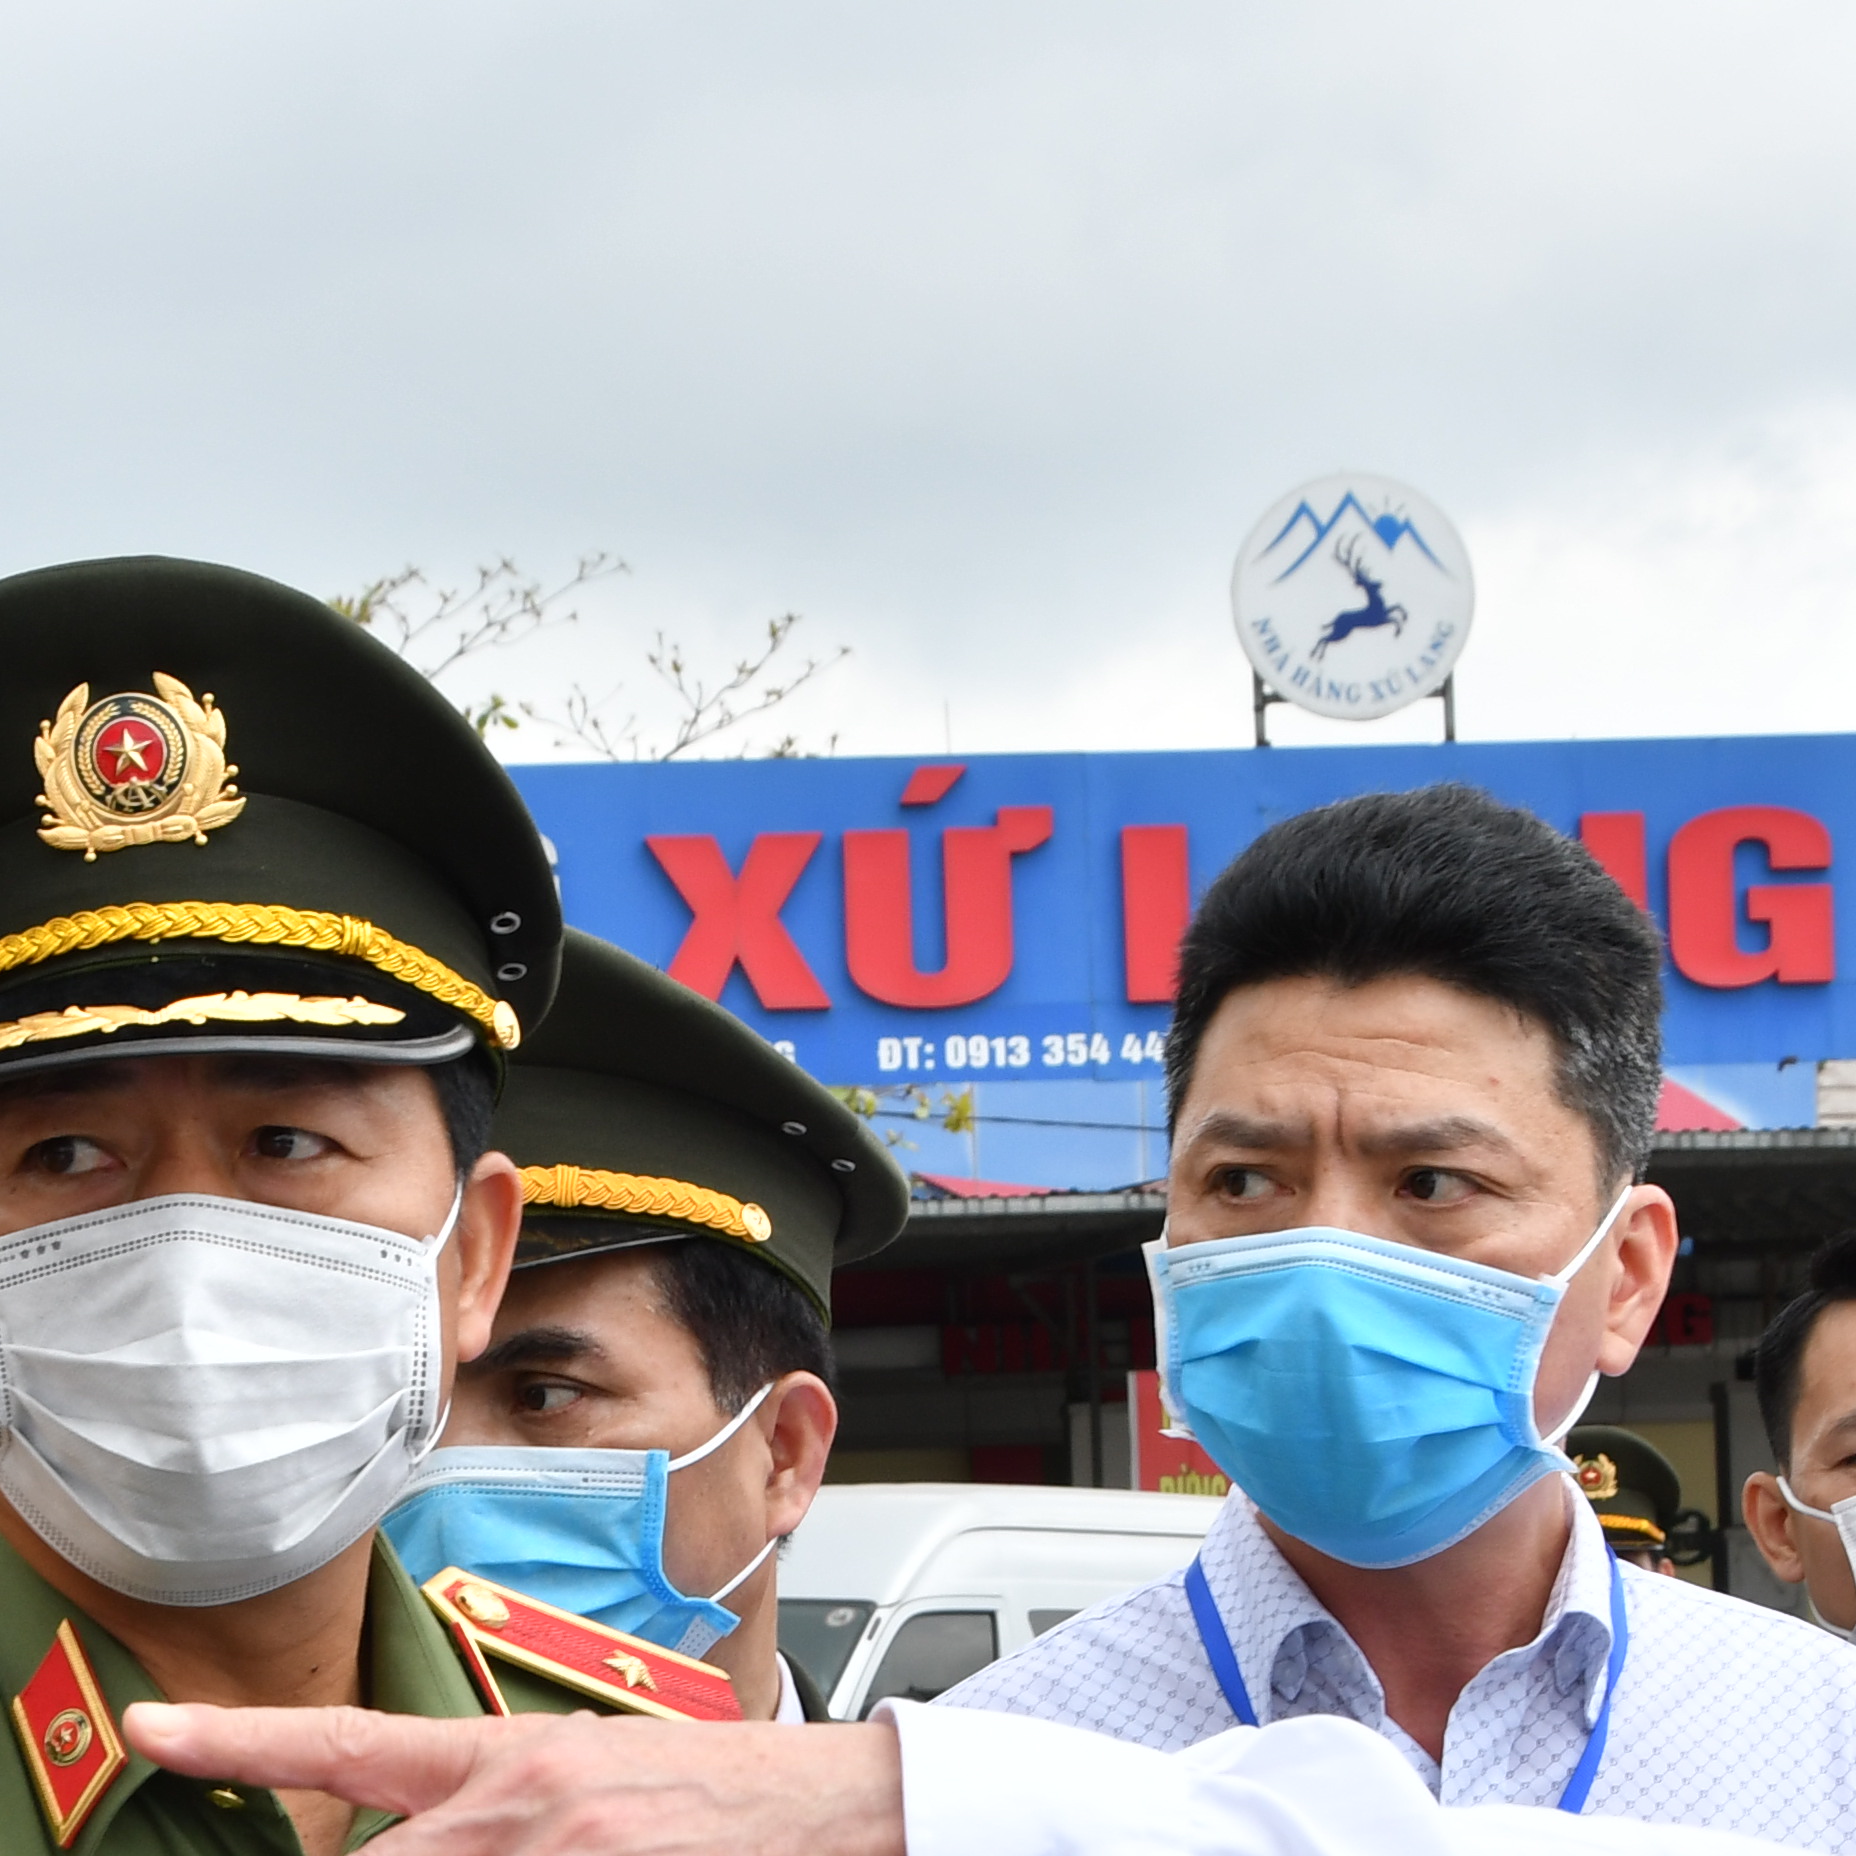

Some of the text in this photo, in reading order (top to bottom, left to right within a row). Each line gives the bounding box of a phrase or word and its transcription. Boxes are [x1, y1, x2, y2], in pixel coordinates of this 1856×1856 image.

[645, 765, 1053, 1010] XỨ
[878, 1037, 936, 1071] ĐT:
[945, 1034, 1031, 1068] 0913
[1042, 1033, 1111, 1066] 354
